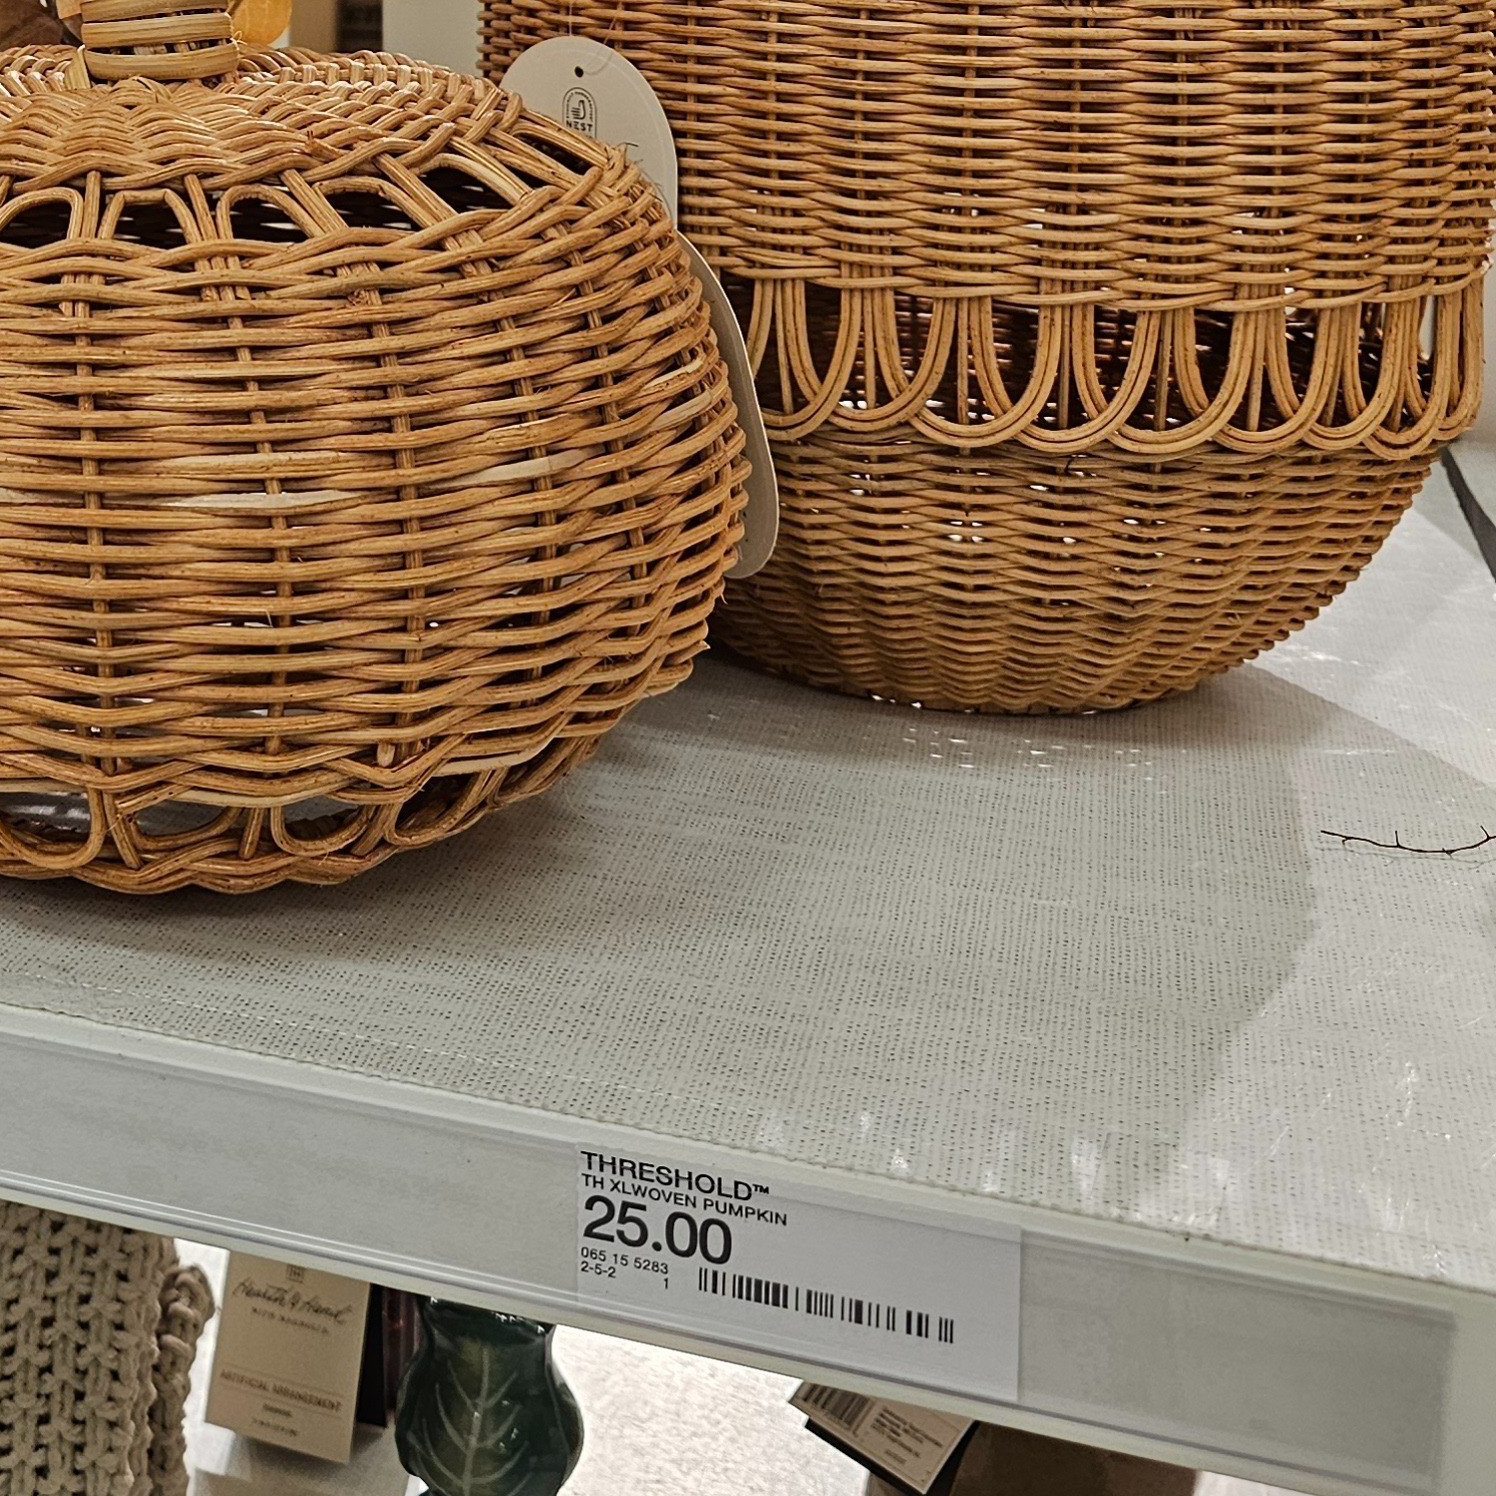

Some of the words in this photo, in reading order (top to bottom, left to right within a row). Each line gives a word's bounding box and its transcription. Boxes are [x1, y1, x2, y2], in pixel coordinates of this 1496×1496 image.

[581, 1173, 604, 1189] TH
[703, 1198, 787, 1226] PUMPKIN
[583, 1194, 732, 1265] 25.00
[580, 1246, 607, 1262] 065
[612, 1253, 629, 1266] 15
[633, 1257, 669, 1275] 5283
[580, 1261, 617, 1279] 2-5-2
[664, 1278, 669, 1290] 1
